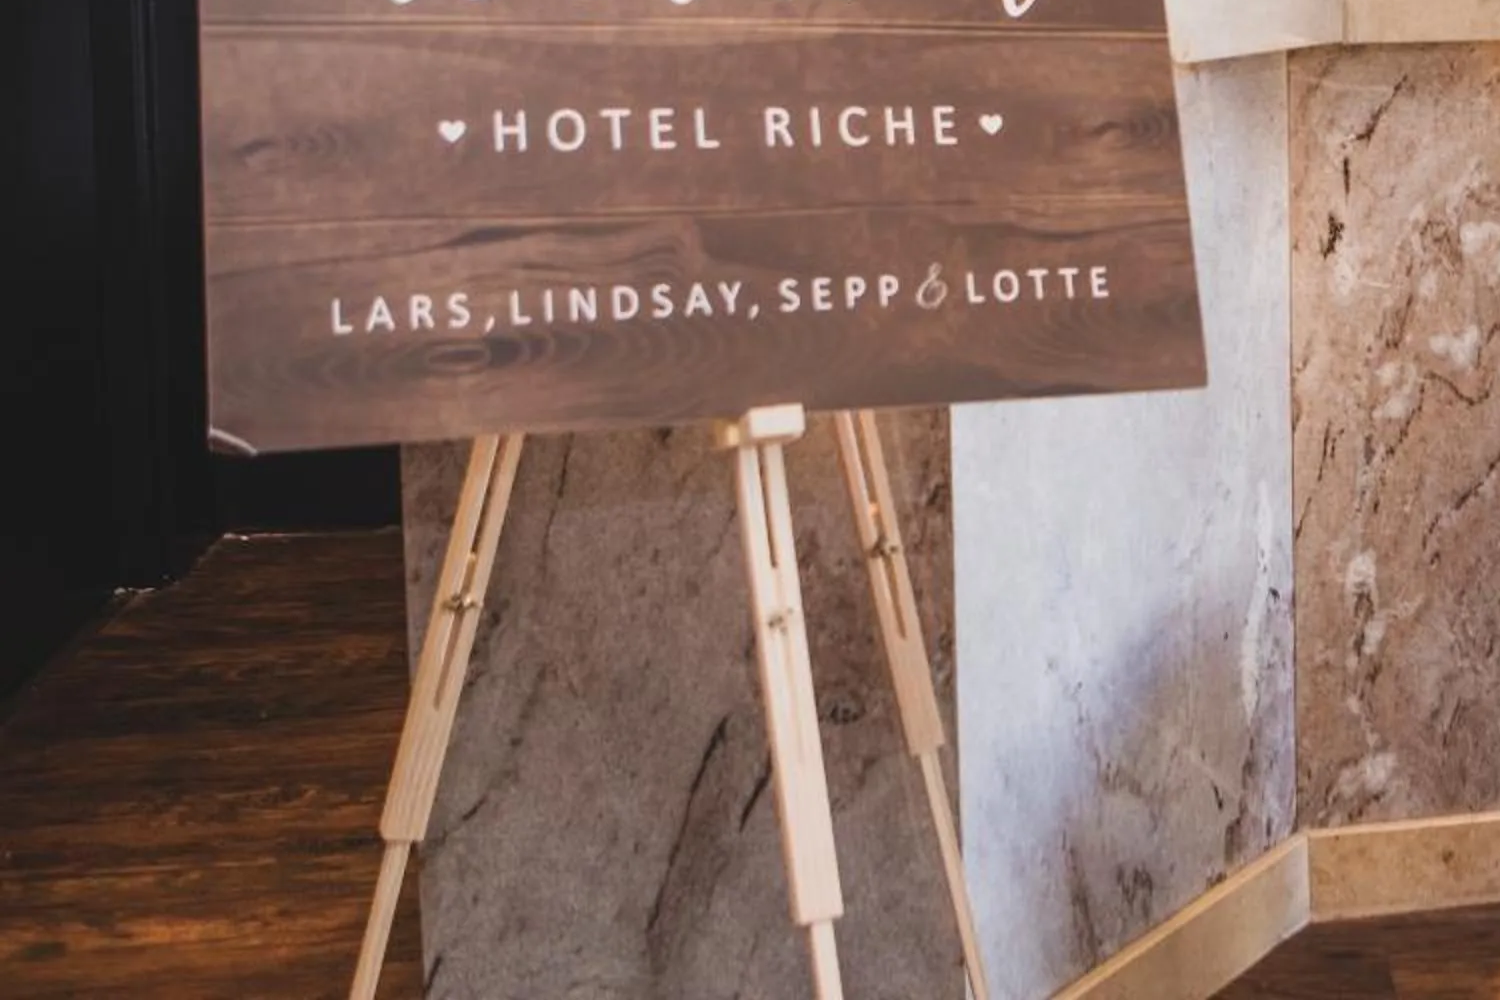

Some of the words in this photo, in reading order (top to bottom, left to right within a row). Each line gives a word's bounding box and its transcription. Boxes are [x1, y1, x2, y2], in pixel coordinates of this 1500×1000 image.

[492, 107, 721, 153] HOTEL
[763, 104, 960, 148] RICHE
[778, 273, 900, 314] SEPP
[964, 265, 1111, 304] LOTTE
